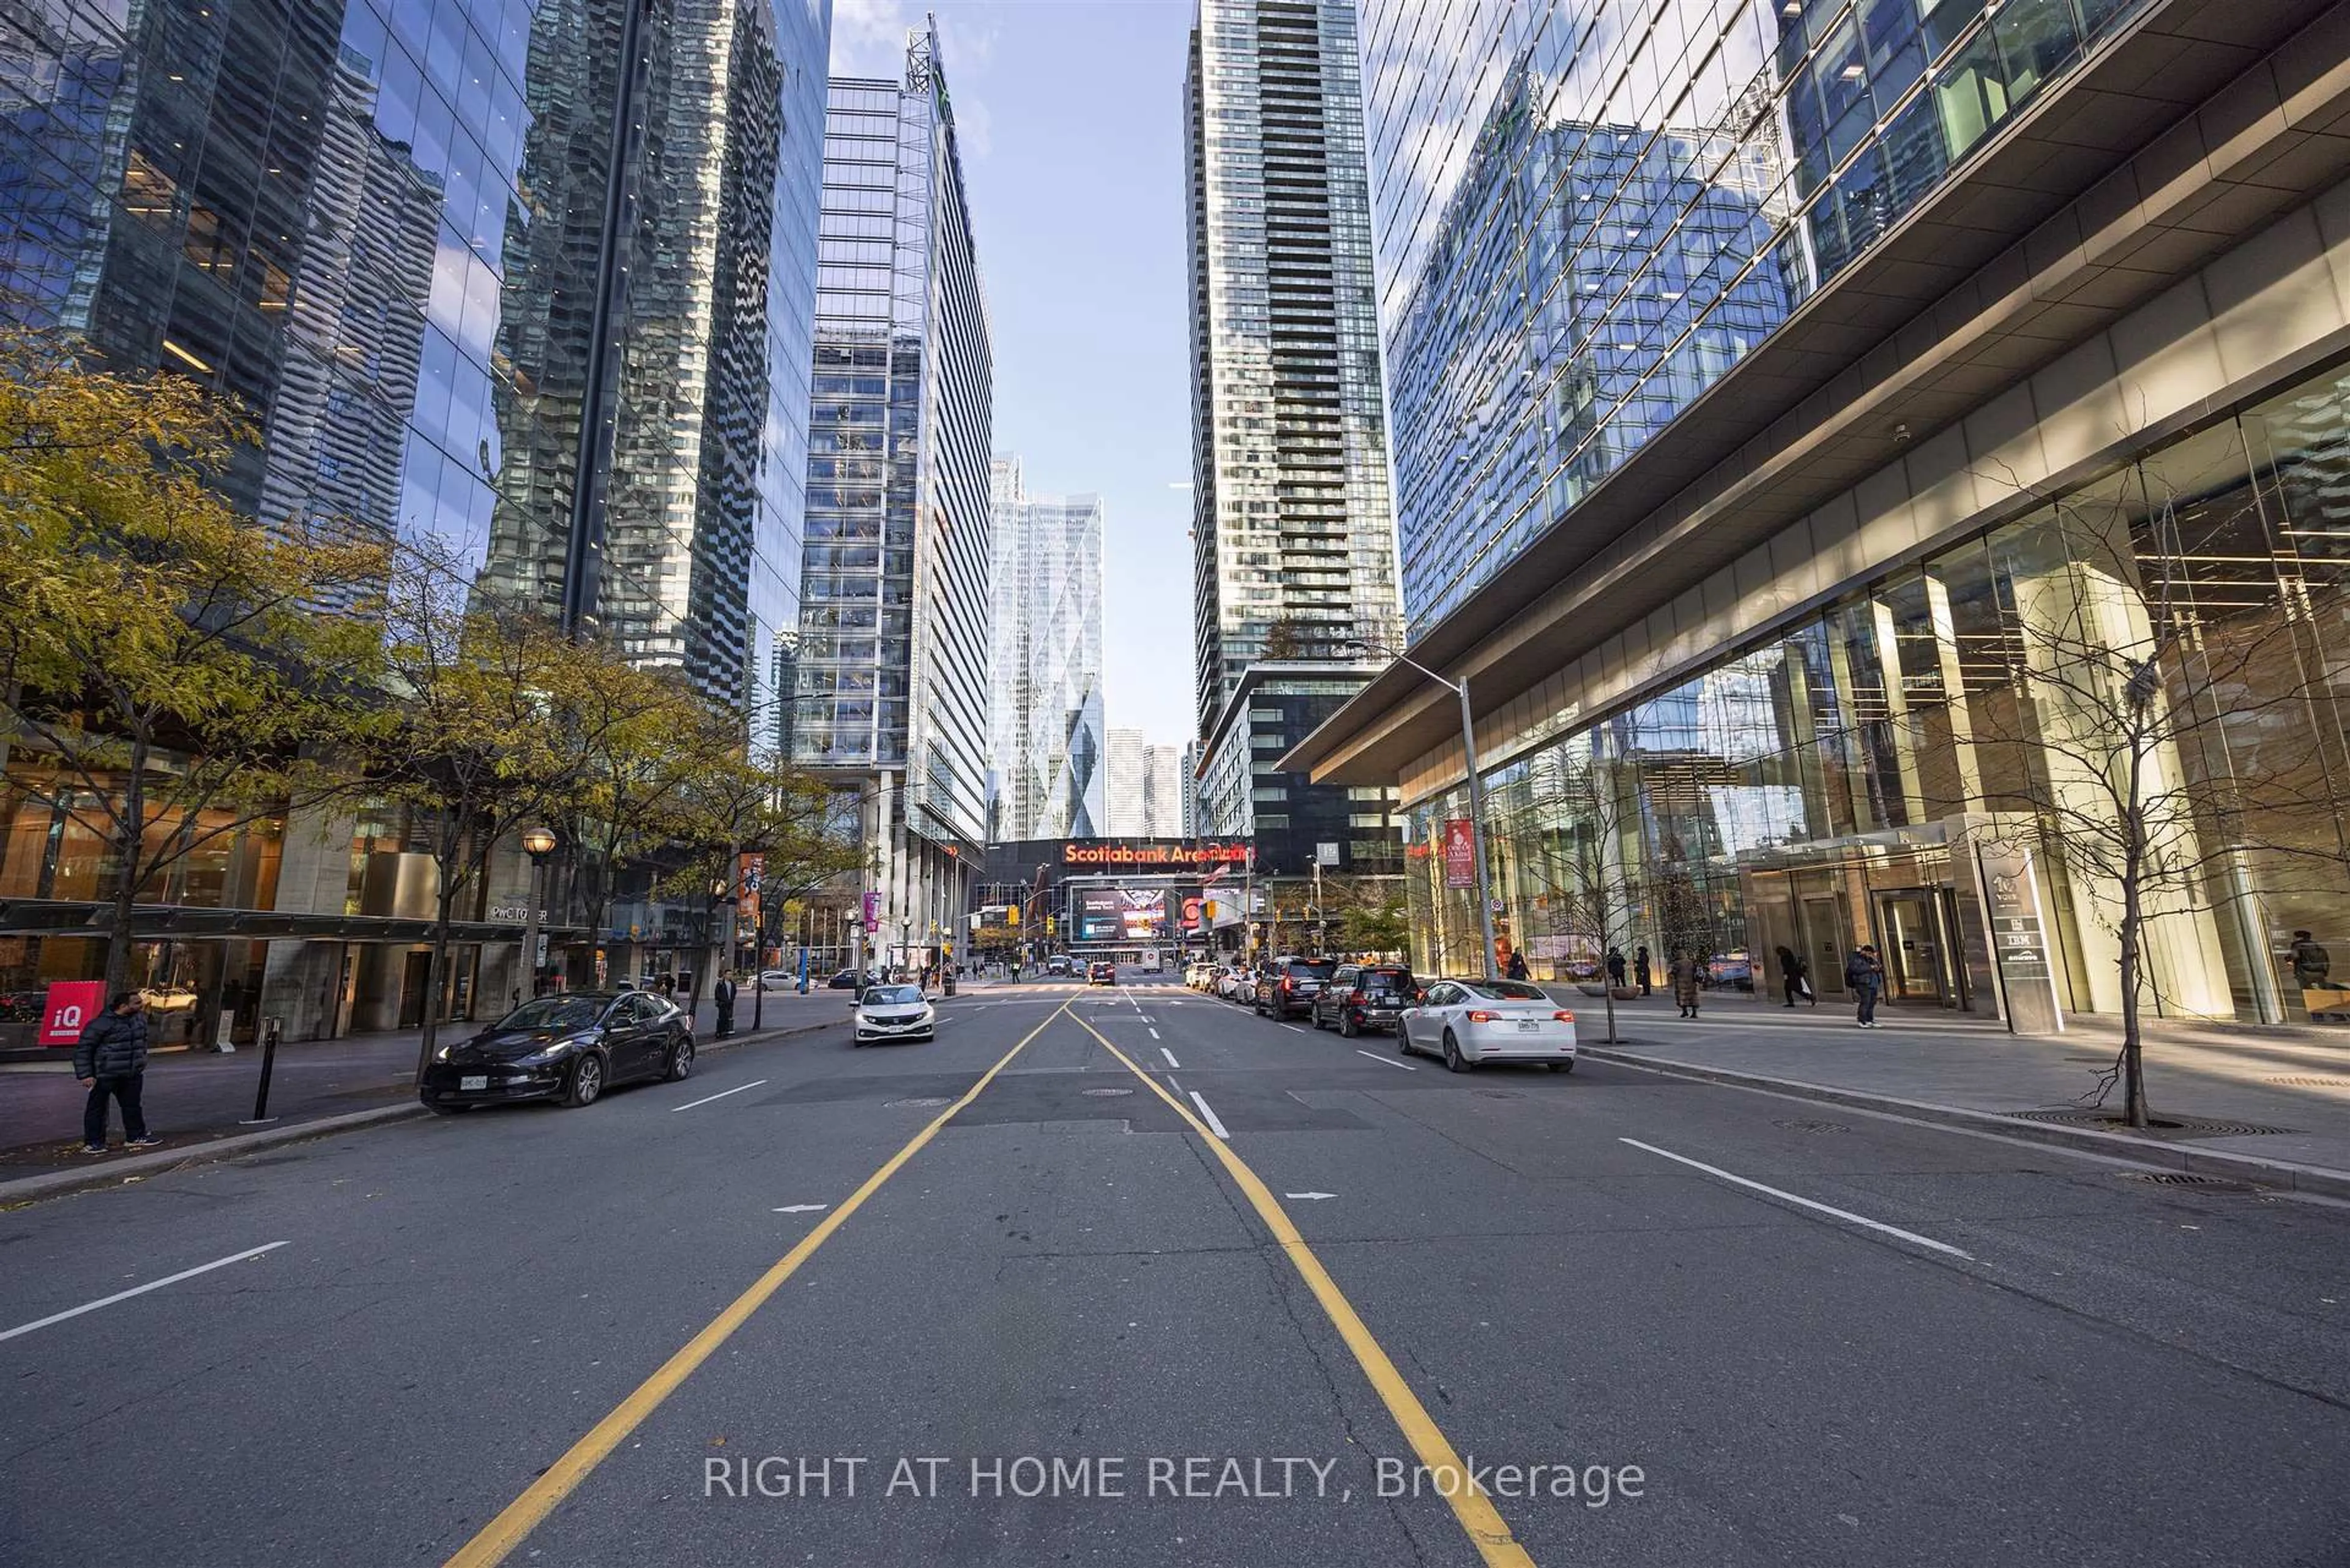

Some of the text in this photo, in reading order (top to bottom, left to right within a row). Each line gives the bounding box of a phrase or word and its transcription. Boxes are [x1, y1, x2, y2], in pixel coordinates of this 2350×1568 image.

[1066, 844, 1226, 862] Scotiabank Are
[516, 908, 547, 920] TOER
[2007, 935, 2031, 946] IBM
[54, 1006, 81, 1027] iQ
